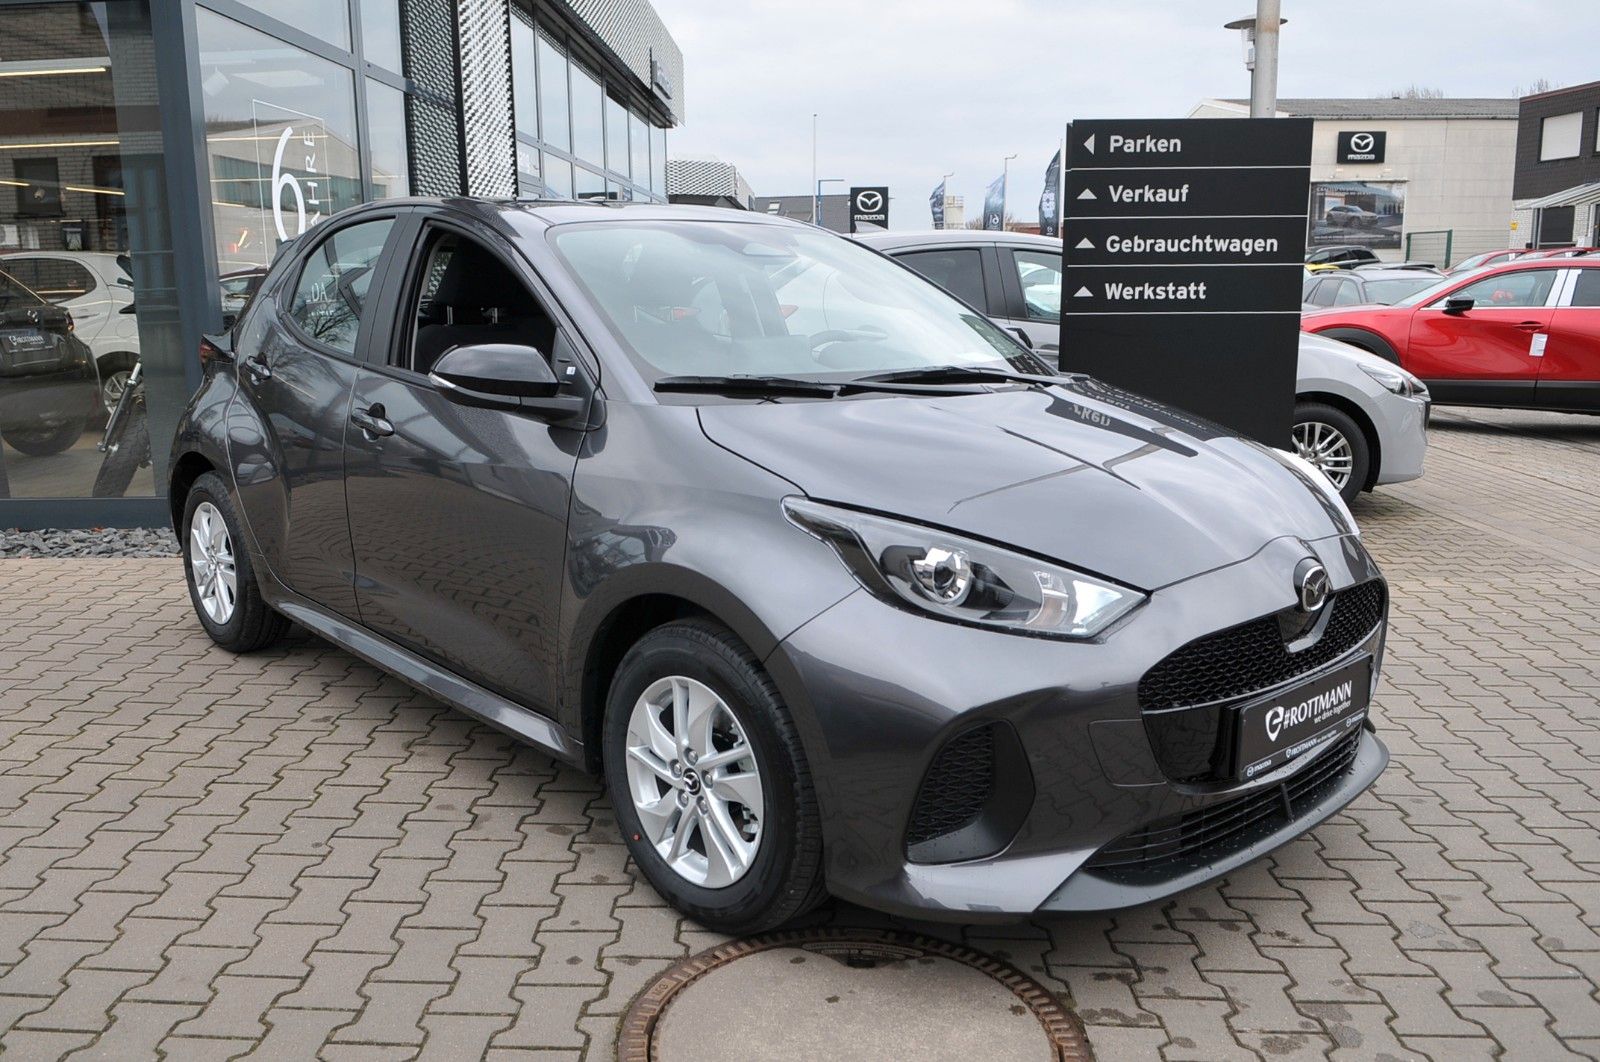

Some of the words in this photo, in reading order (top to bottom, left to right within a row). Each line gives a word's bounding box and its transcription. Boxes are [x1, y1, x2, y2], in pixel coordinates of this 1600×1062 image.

[1109, 135, 1182, 153] Parken
[303, 131, 321, 227] AHRE
[1108, 184, 1190, 203] Verkauf
[1105, 234, 1279, 256] Gebrauchtwagen
[1104, 281, 1207, 300] Werkstatt
